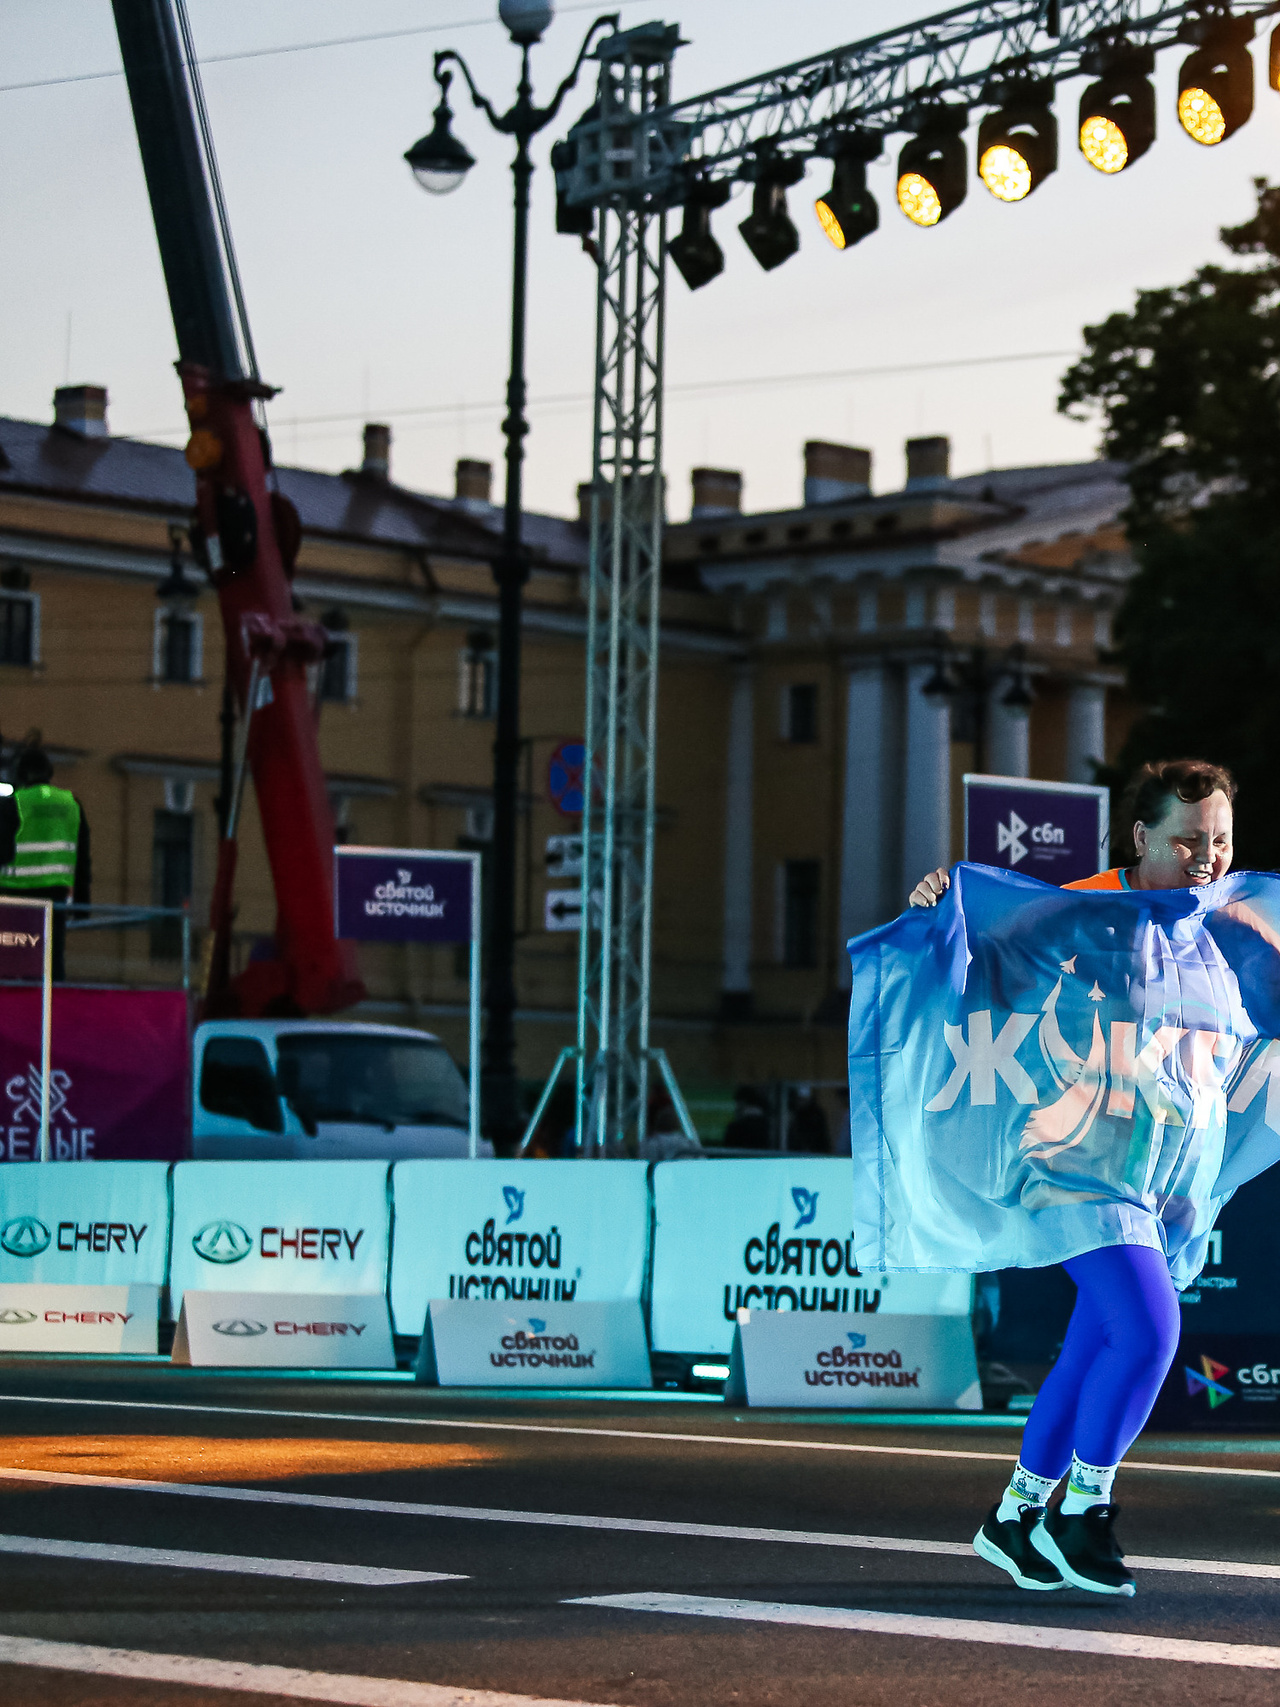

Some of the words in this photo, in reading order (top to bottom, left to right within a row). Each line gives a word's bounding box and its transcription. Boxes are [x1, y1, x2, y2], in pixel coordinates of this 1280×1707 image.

[1031, 822, 1065, 844] сбп
[0, 931, 40, 948] ERY
[57, 1222, 149, 1255] CHERY
[260, 1227, 365, 1261] CHERY
[465, 1217, 562, 1269] святой
[44, 1310, 135, 1325] CHERY
[273, 1321, 368, 1338] CHERY
[816, 1345, 903, 1369] святой
[804, 1370, 920, 1388] источник
